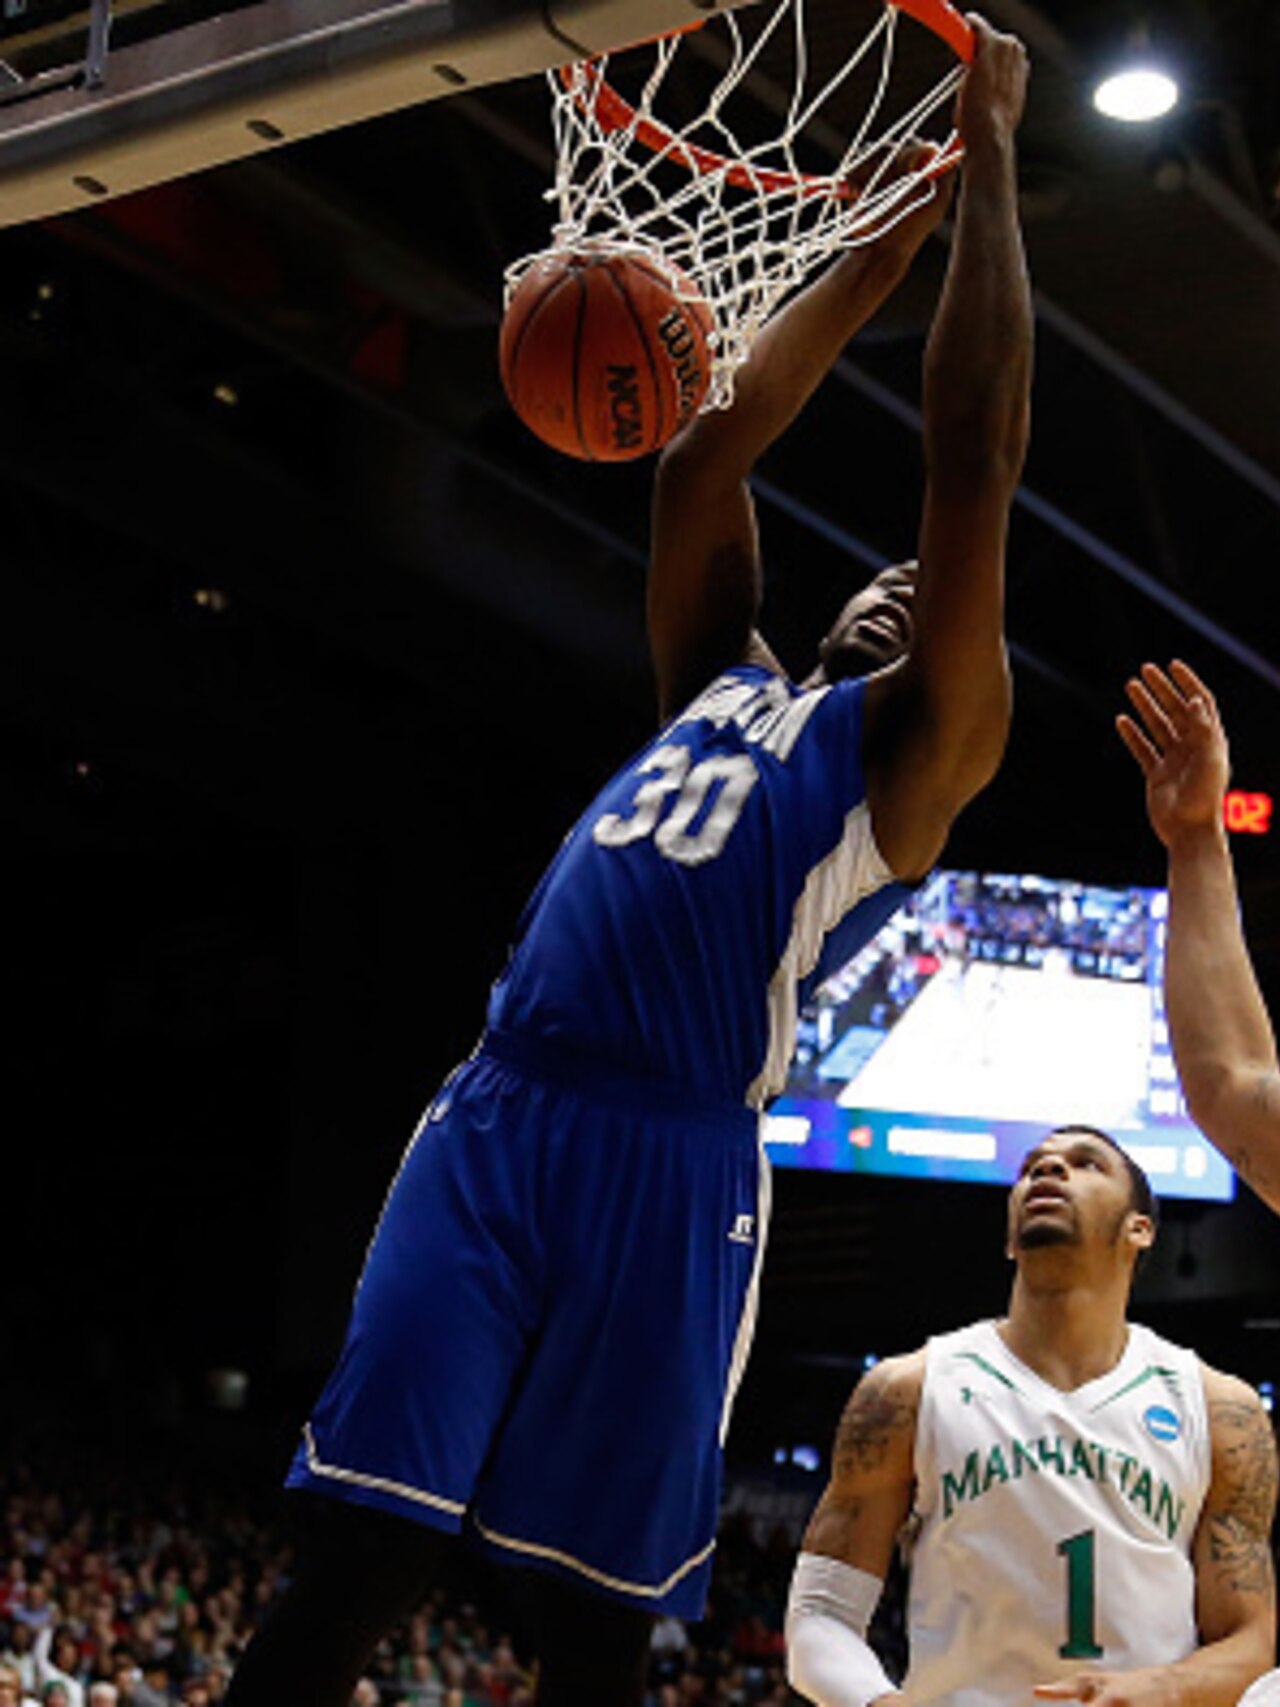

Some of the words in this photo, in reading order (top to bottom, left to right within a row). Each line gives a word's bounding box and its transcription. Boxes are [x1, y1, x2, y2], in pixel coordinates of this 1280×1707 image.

[606, 363, 644, 451] NCAA
[592, 743, 759, 867] 30
[1224, 790, 1273, 835] 02
[940, 1435, 1186, 1540] MANHATTAN
[1056, 1529, 1104, 1660] 1
